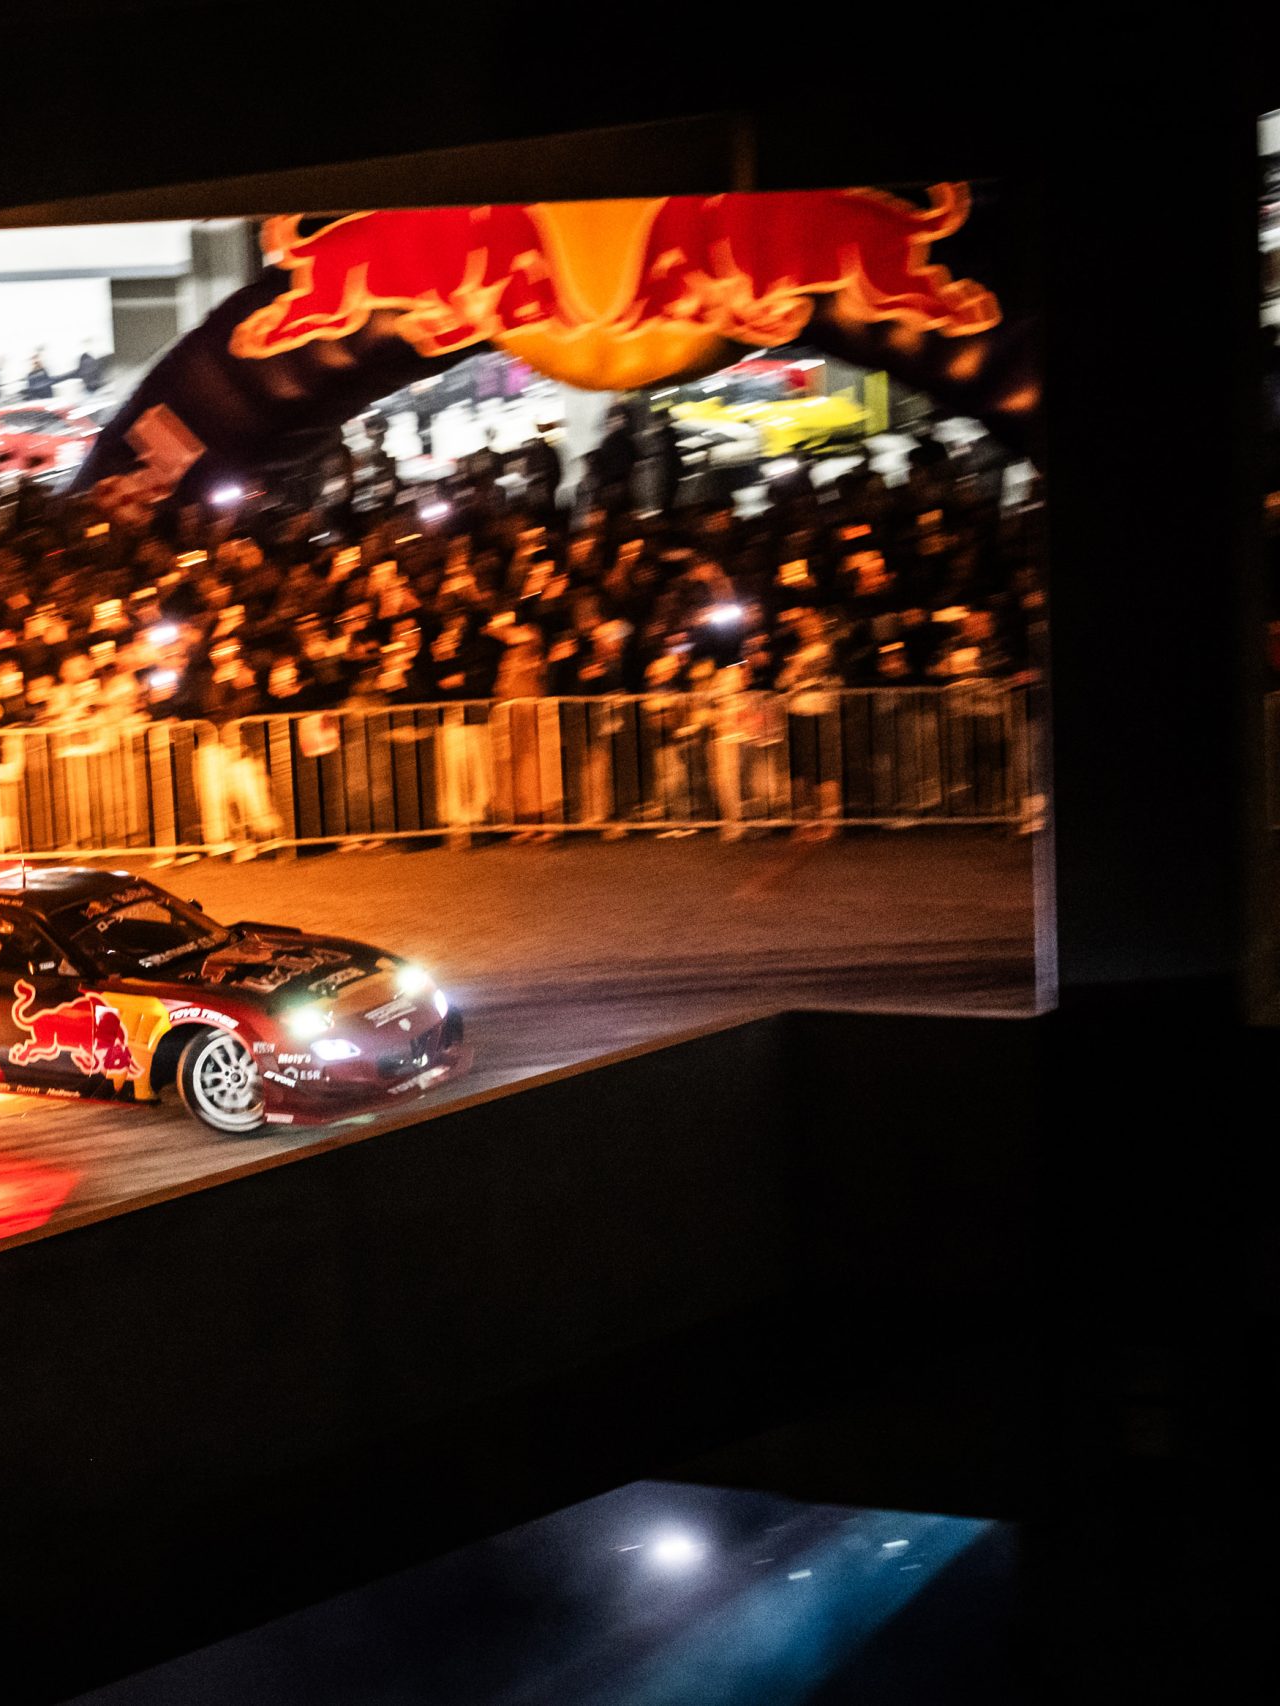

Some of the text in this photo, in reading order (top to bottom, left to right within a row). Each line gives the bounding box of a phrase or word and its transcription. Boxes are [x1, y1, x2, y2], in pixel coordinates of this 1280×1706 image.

[169, 1007, 240, 1030] TOYO TIRES
[278, 1053, 312, 1065] Moty's
